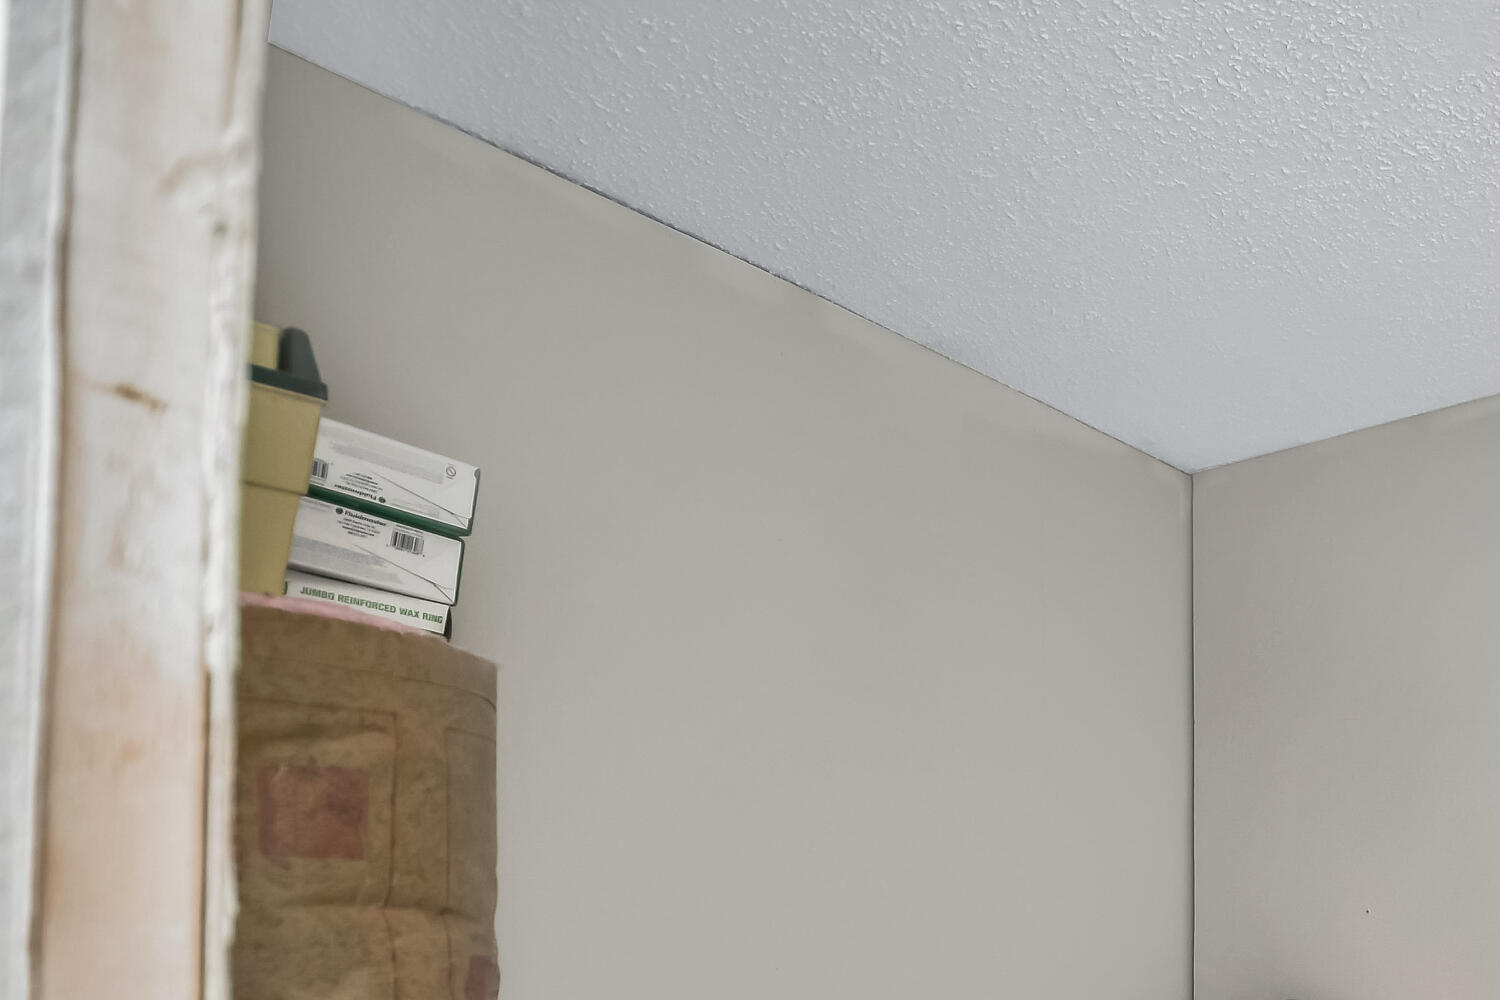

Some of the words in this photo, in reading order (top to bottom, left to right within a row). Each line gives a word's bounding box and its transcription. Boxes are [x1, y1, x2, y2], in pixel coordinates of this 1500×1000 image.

[300, 586, 335, 601] JUMBO
[337, 594, 397, 614] REINFORCED
[399, 607, 420, 619] WAX
[422, 612, 444, 624] RING
